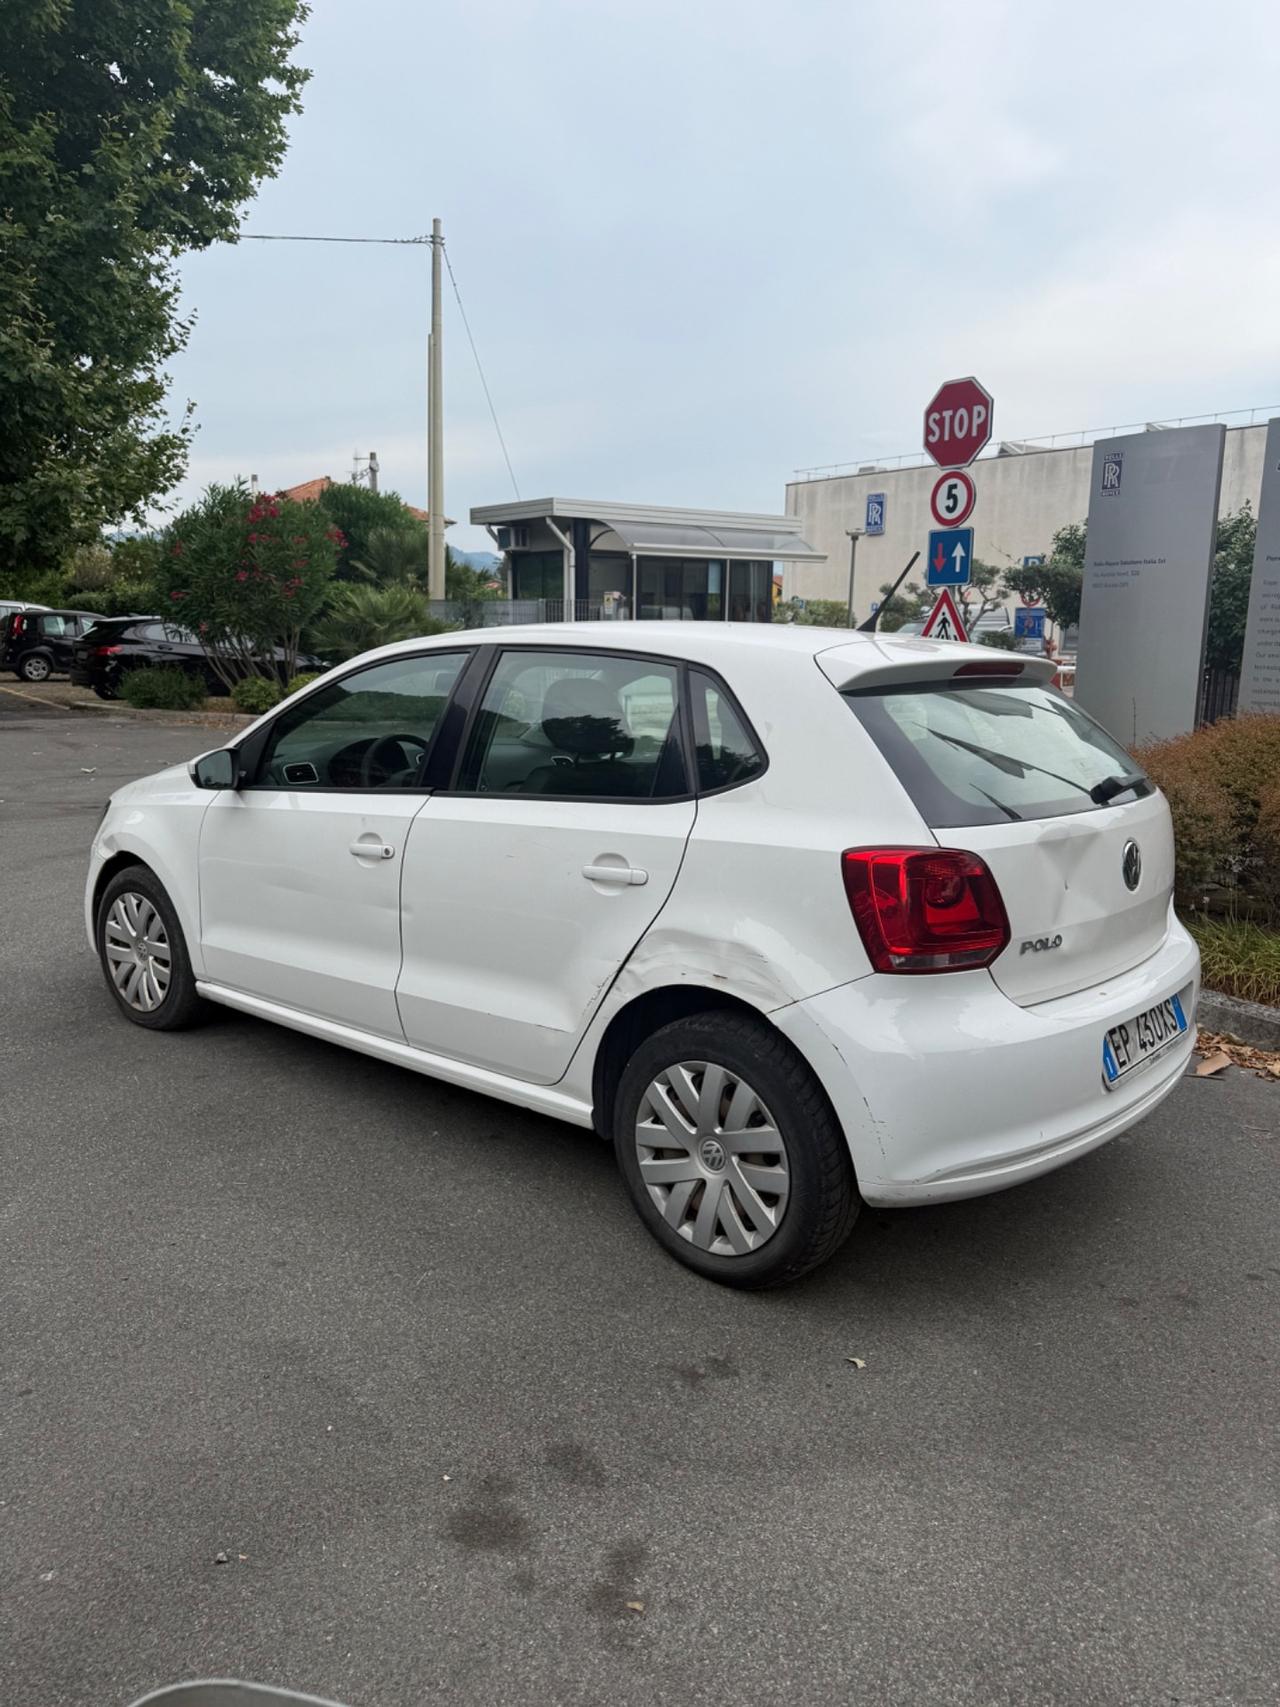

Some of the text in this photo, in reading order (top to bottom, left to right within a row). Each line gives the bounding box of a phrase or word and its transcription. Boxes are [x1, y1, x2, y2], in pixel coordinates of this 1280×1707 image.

[927, 404, 986, 443] STOP
[945, 483, 959, 514] 5
[1019, 934, 1062, 956] POLO
[1107, 998, 1178, 1069] EP 430XS
